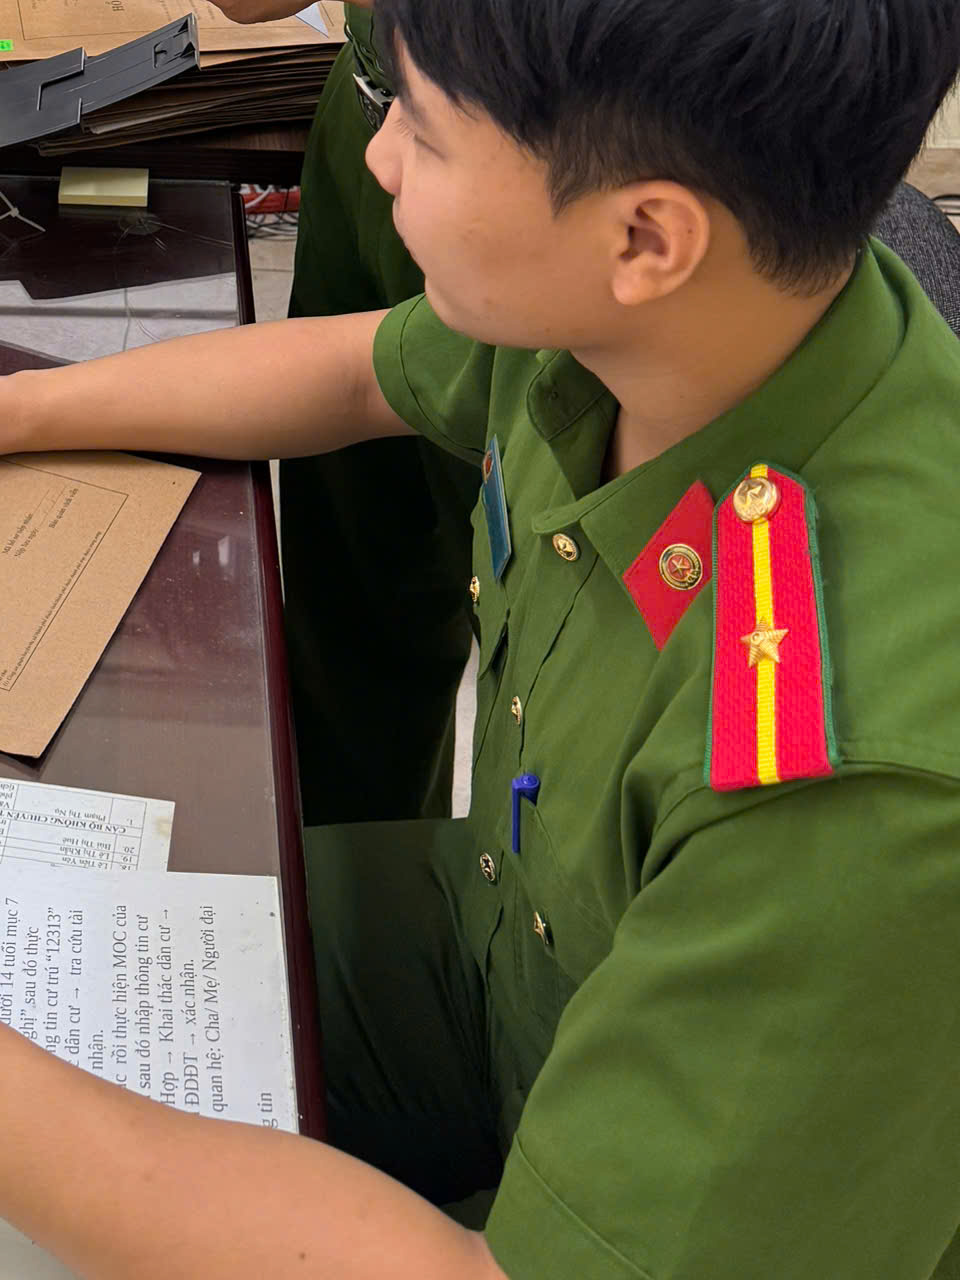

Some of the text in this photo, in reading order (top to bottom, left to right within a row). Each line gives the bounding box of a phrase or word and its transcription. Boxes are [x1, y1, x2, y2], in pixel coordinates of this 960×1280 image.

[5, 896, 18, 904] 7
[6, 909, 20, 936] mục
[0, 941, 16, 966] tuổi
[23, 926, 40, 955] thực
[0, 972, 14, 987] 14
[21, 959, 37, 976] đó
[44, 966, 58, 984] trú
[24, 981, 36, 1004] sau
[64, 910, 82, 1054] dân cư tra cứu tài
[111, 904, 129, 1064] rồi thực hiện MOC của
[46, 988, 58, 1006] cư
[134, 914, 153, 1088] sau đó nhập thông tin cư
[199, 905, 228, 1112] quan hệ: Cha/ Mẹ/ Người đại
[42, 1012, 57, 1030] tin
[156, 924, 178, 1104] Hợp Khai thác dân cư
[179, 958, 200, 1104] ĐDĐT xác nhận.
[88, 1029, 106, 1070] nhận.
[257, 1092, 272, 1112] tin
